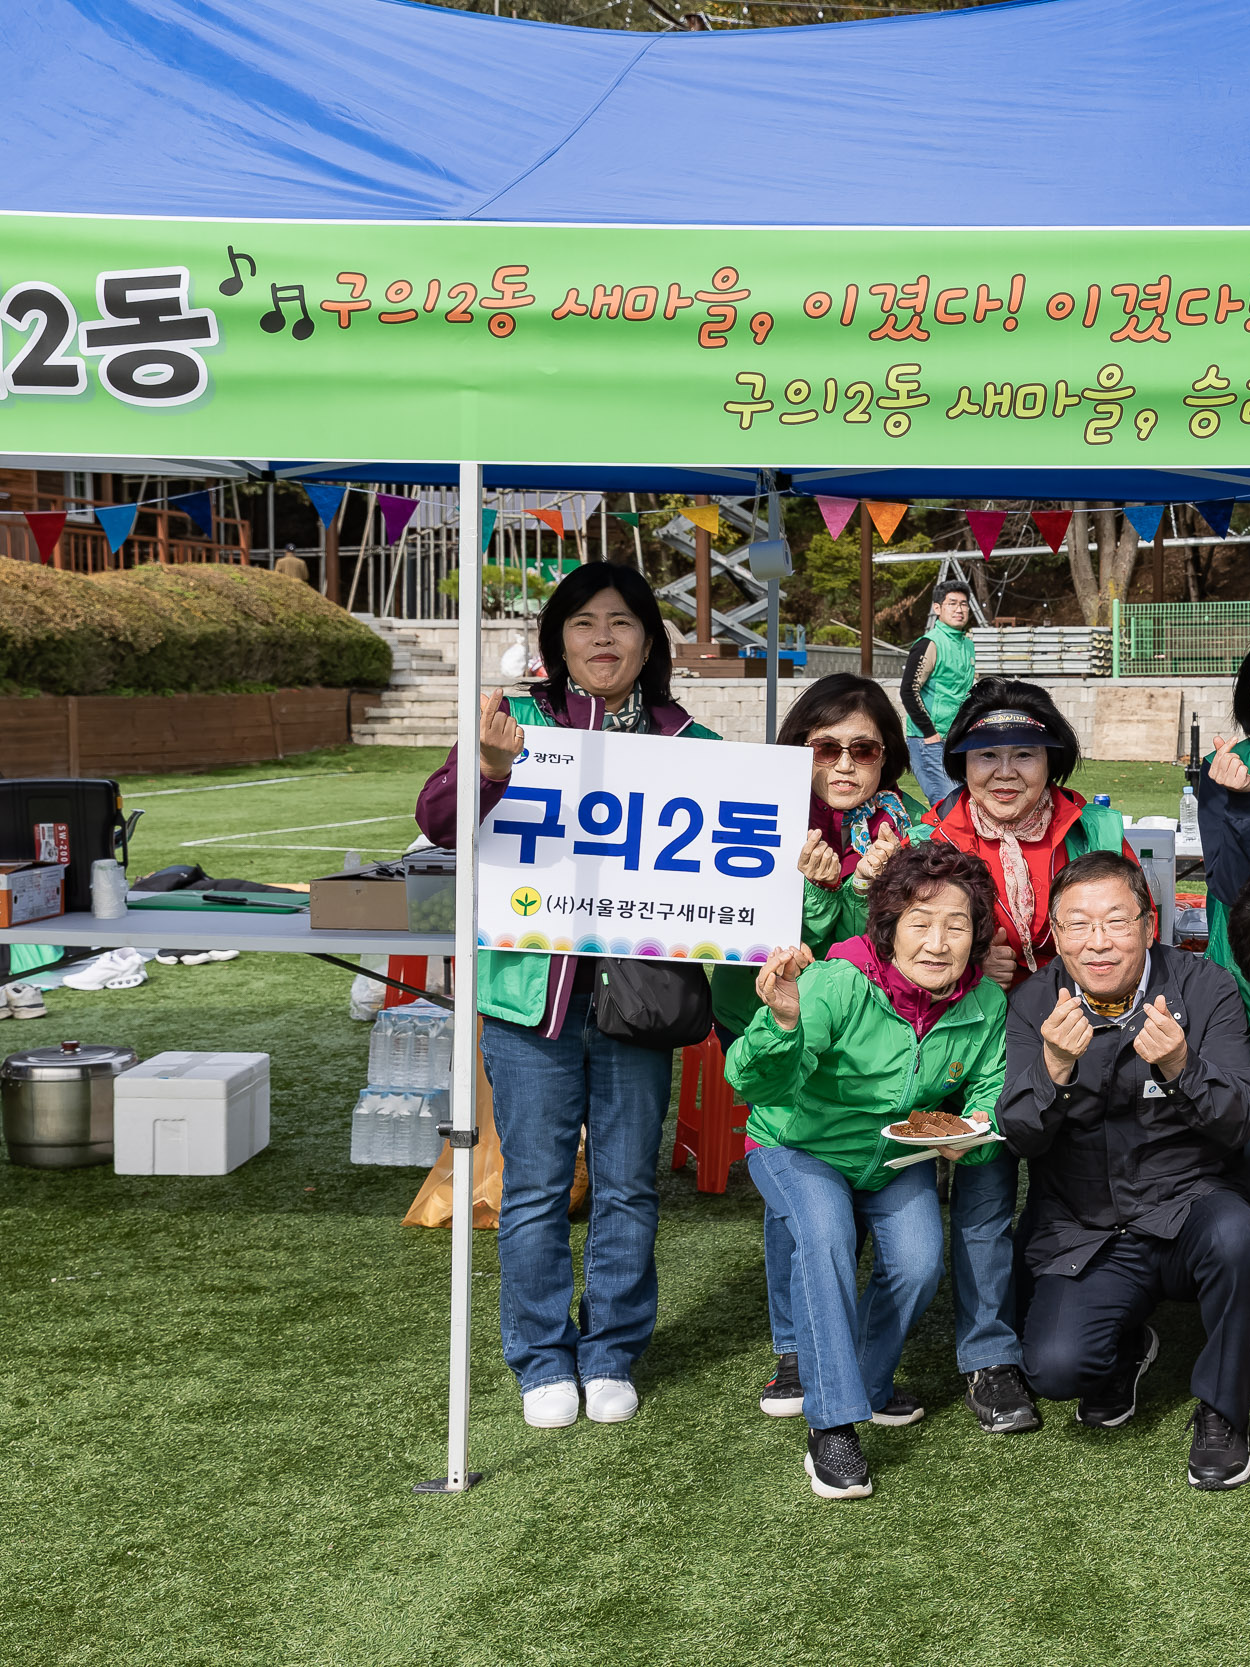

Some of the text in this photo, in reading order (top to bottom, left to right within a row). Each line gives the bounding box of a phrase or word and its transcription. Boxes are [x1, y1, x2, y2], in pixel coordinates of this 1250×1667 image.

[320, 264, 535, 338] 구의2동
[551, 266, 774, 348] 새마을,
[803, 273, 1026, 342] 이겼다!
[724, 362, 930, 438] 구의2동
[947, 362, 1159, 446] 새마을,
[533, 751, 575, 765] 광진구
[58, 825, 69, 863] SW-200
[493, 785, 781, 878] 구의2동
[546, 894, 755, 926] (사)서울광진구새마을회
